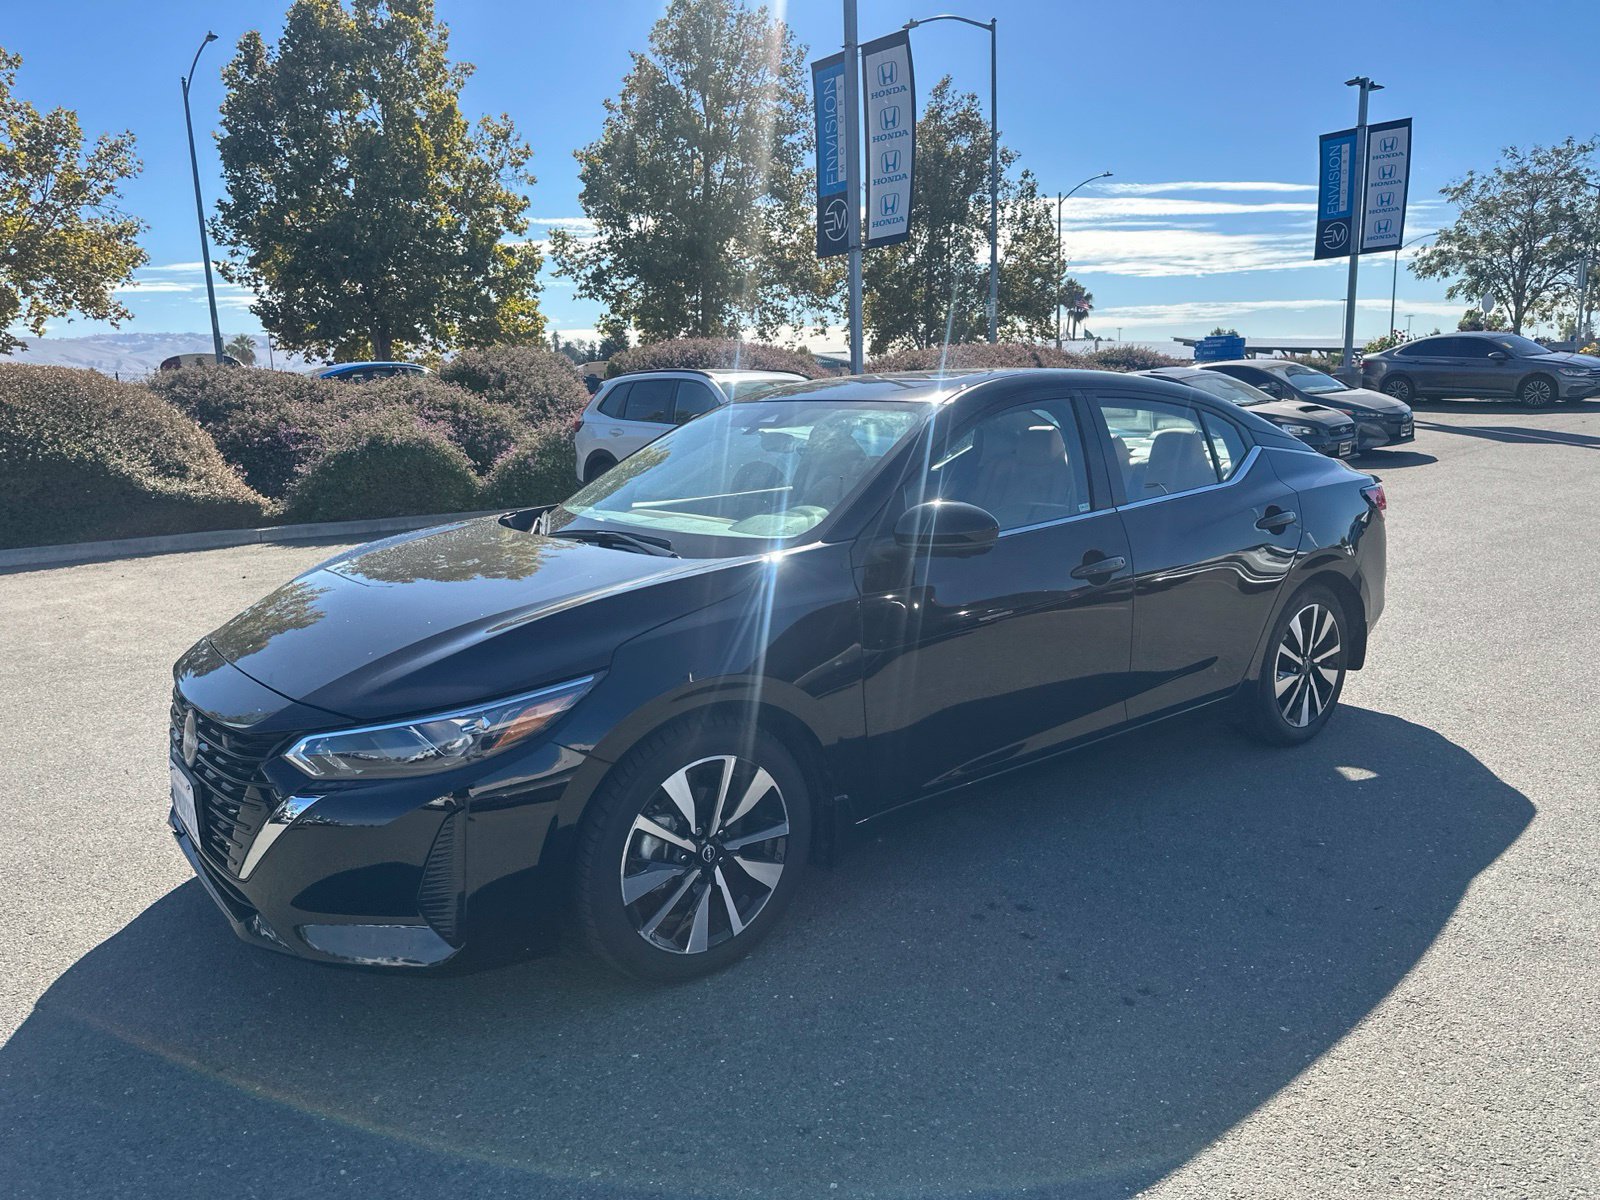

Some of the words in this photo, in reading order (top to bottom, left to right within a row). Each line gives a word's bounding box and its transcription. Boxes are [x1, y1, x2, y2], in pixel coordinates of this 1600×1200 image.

[871, 85, 907, 100] HONDA
[823, 77, 838, 186] ENVISION
[872, 129, 909, 143] HONDA
[1372, 151, 1405, 160] HONDA
[873, 172, 908, 186] HONDA
[1327, 145, 1341, 215] ENVISION
[1370, 179, 1403, 188] HONDA
[1368, 206, 1401, 215] HONDA
[872, 215, 905, 228] HONDA
[1366, 233, 1398, 241] HONDA
